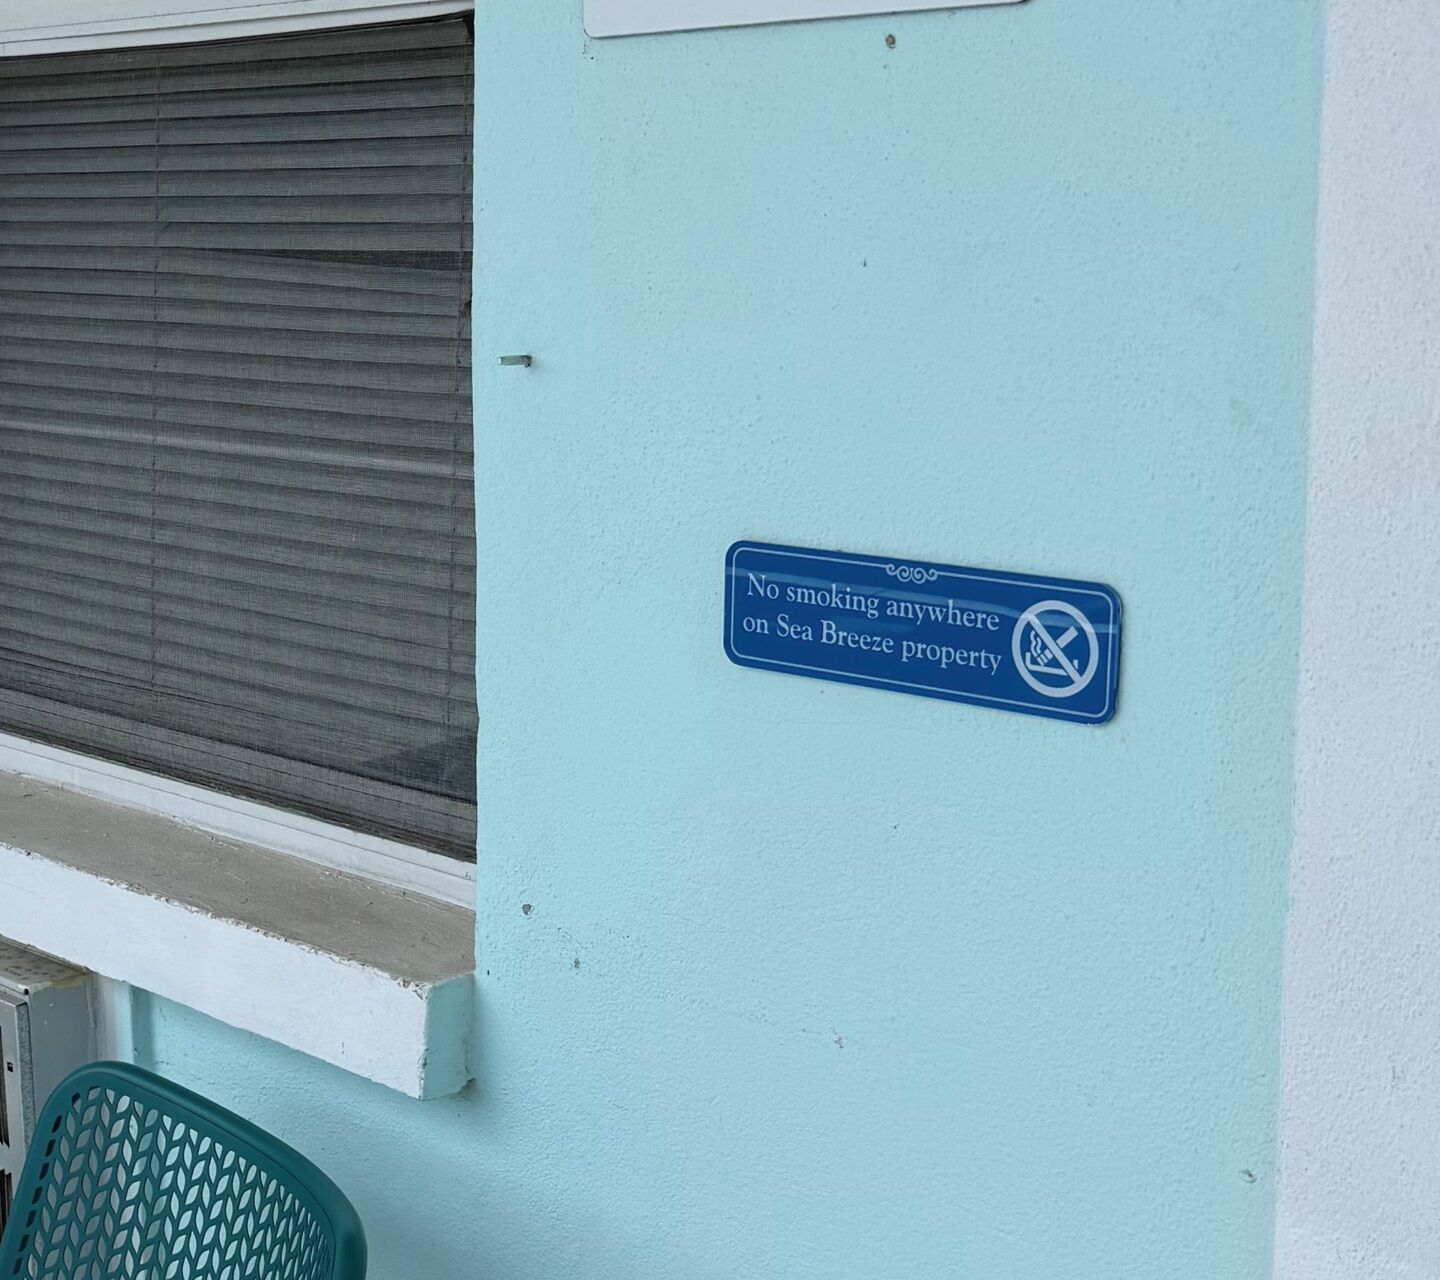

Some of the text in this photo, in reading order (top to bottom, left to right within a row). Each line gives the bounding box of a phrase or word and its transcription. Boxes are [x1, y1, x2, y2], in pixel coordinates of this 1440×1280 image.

[746, 571, 1001, 631] No smoking anywhere
[742, 613, 1003, 676] on Sea Breeze property
